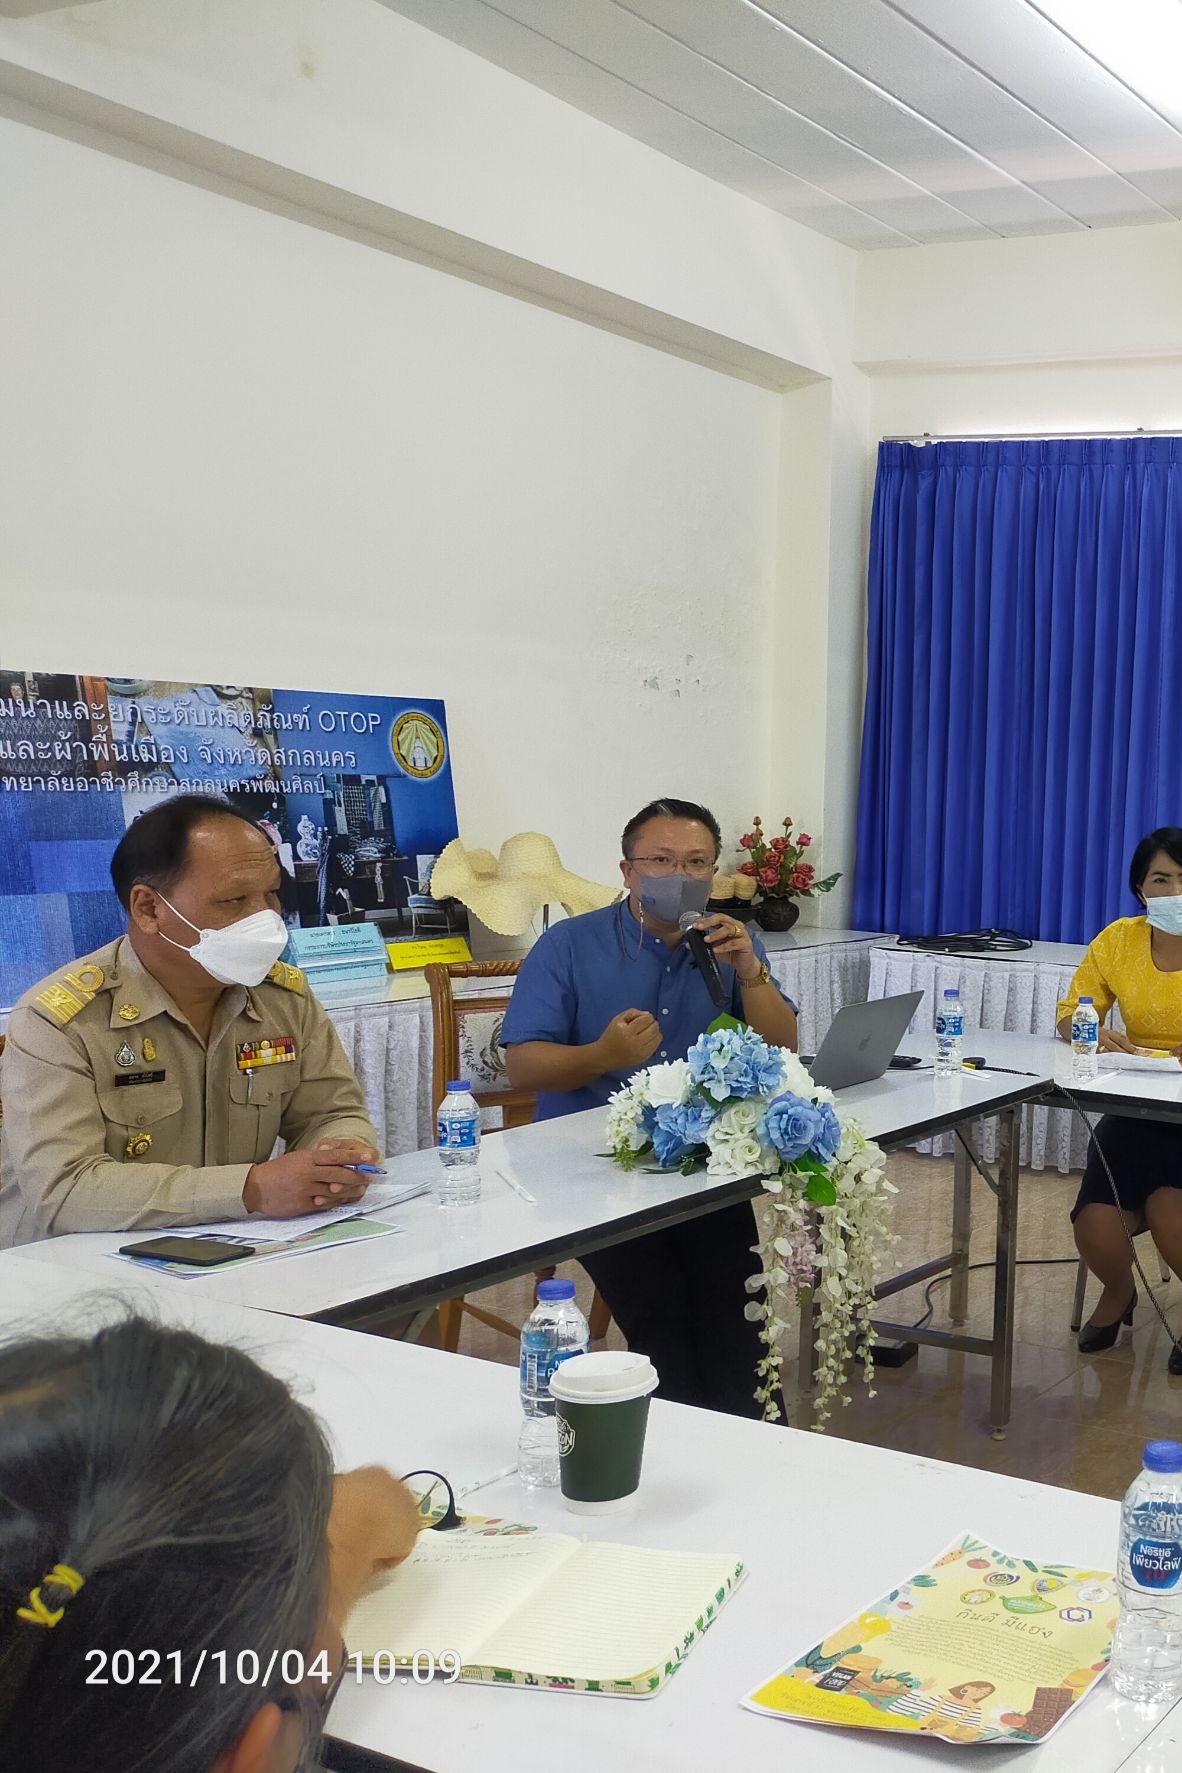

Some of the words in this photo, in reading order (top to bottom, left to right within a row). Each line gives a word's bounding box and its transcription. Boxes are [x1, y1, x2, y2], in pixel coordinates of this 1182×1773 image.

[318, 710, 381, 734] OTOP
[199, 737, 357, 768] จังหวัดสกลนคร
